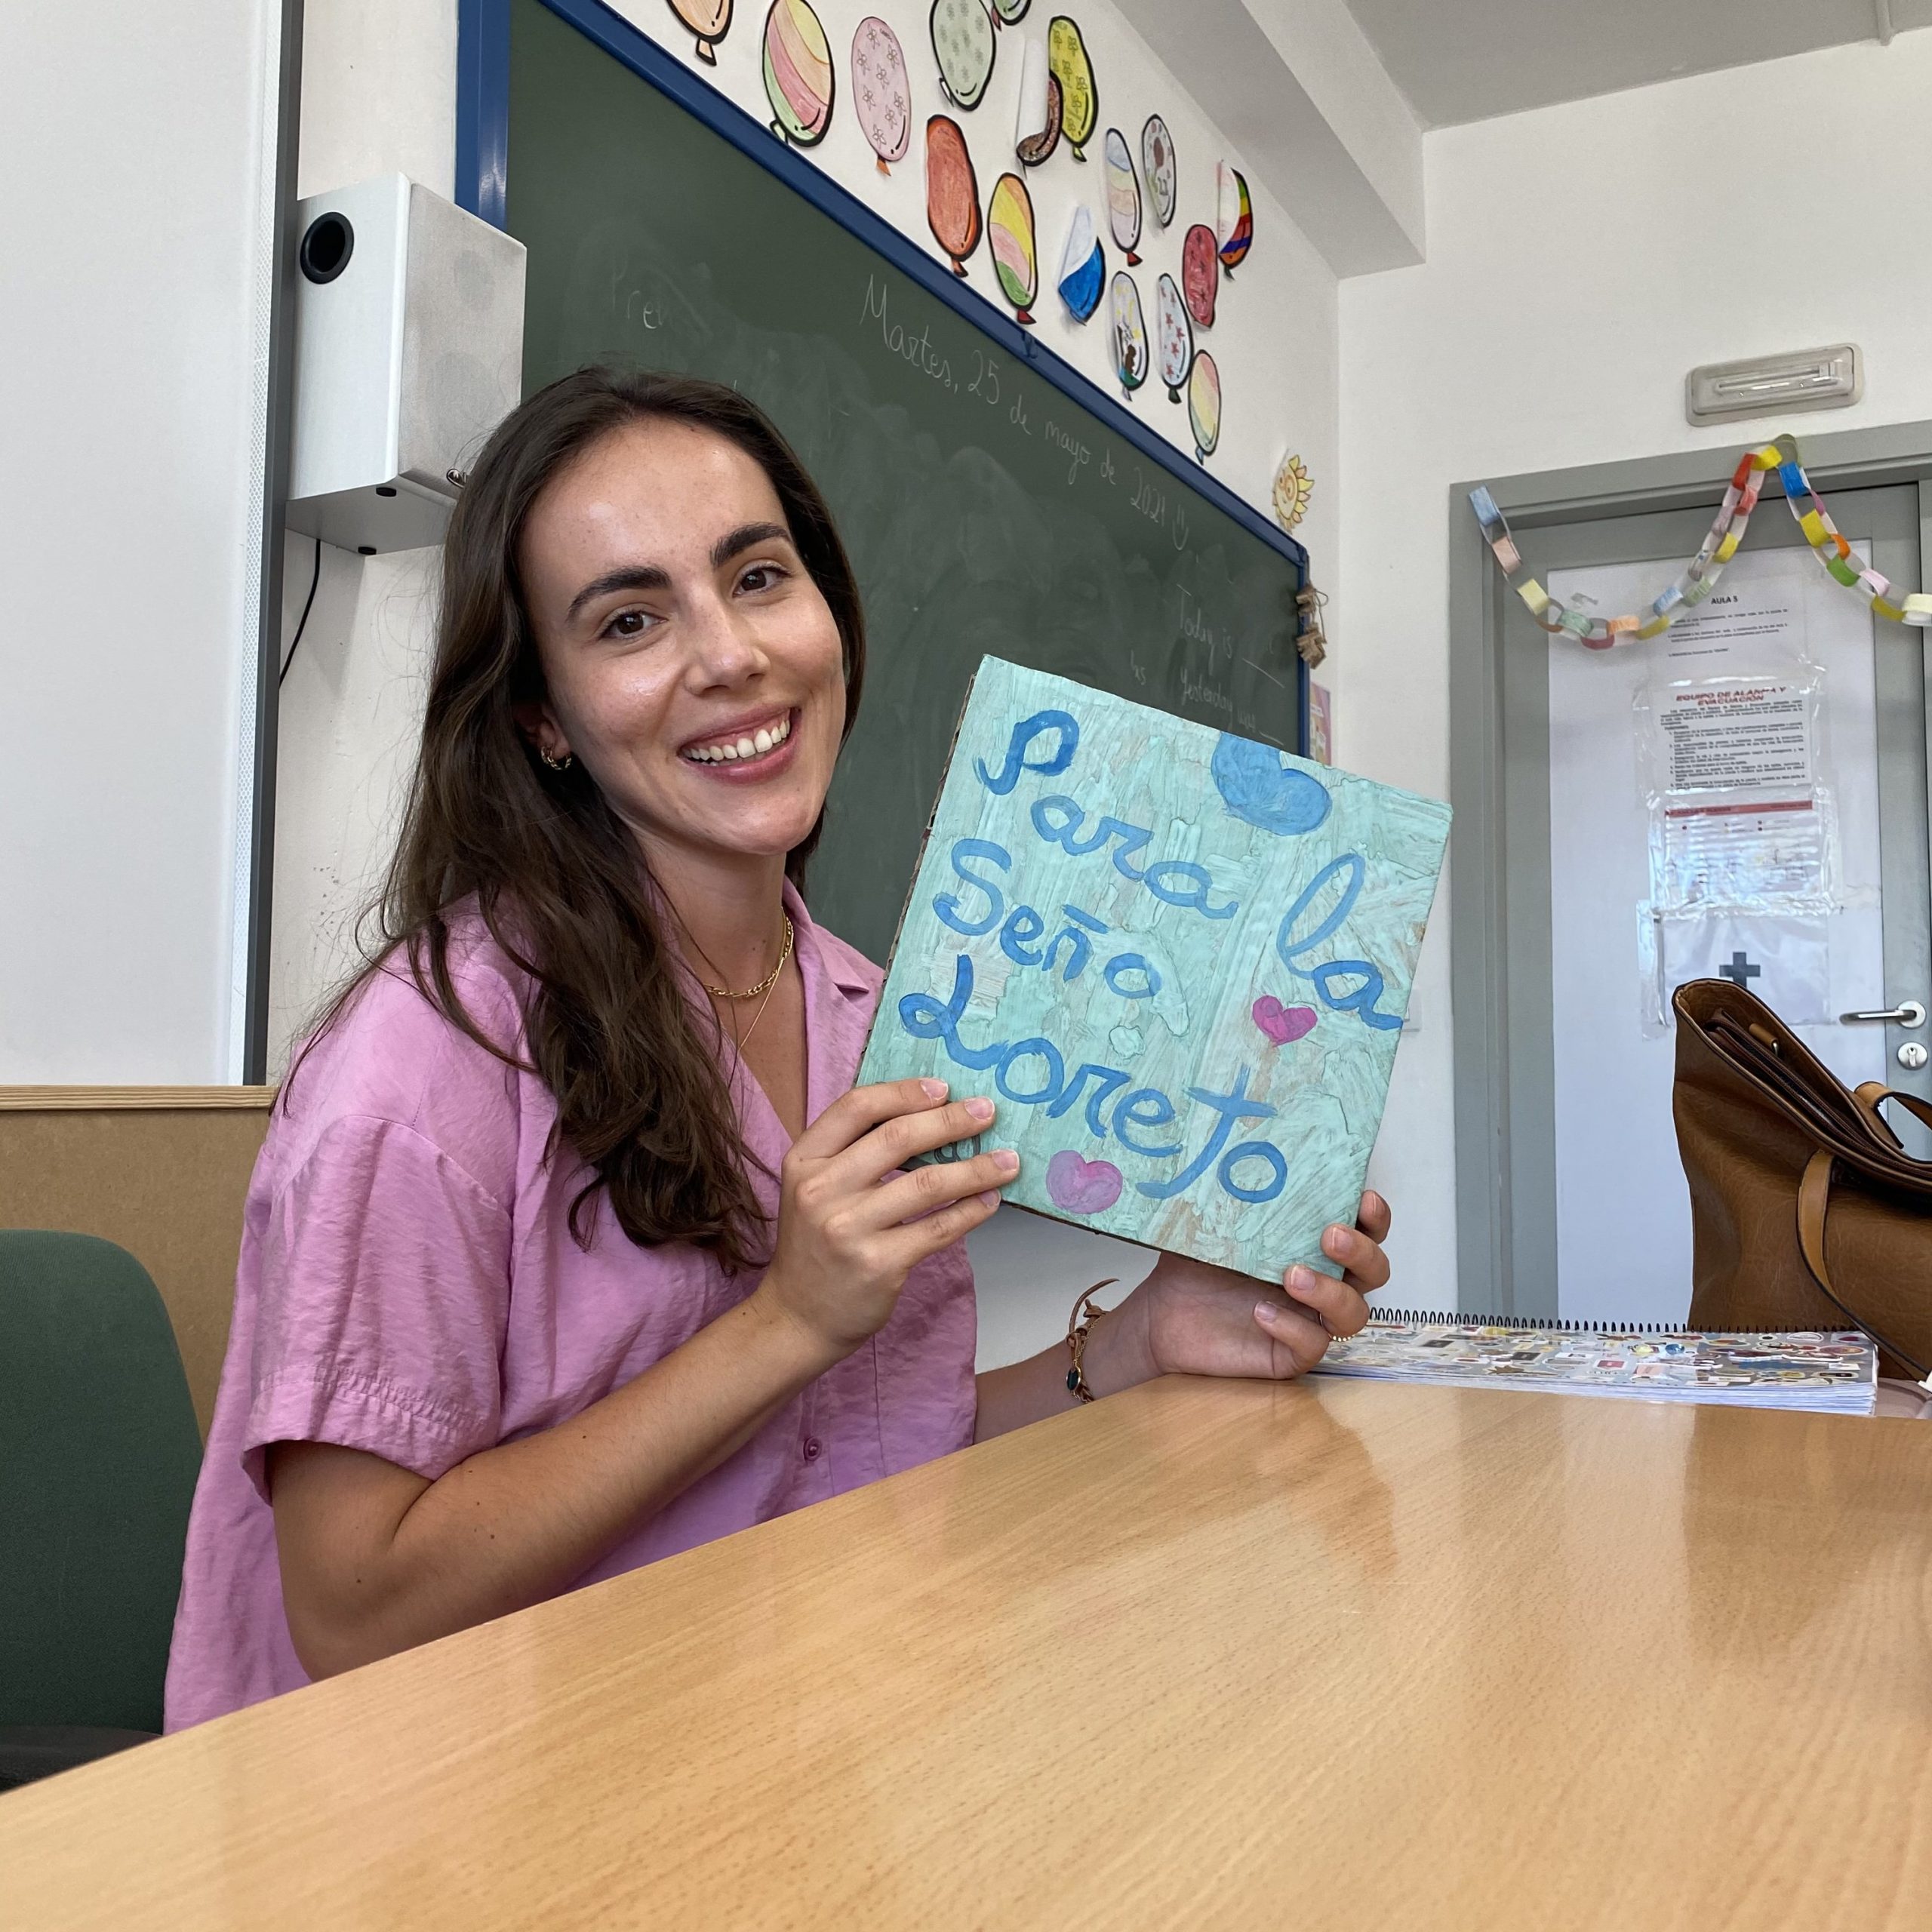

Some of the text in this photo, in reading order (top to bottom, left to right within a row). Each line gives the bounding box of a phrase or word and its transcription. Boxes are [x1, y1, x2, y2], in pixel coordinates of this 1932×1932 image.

[859, 273, 1166, 528] Martes, 25 de mayo de 2021
[1177, 583, 1216, 676] Today
[1711, 596, 1731, 605] AULA
[1676, 691, 1715, 702] EQUIPO
[932, 838, 1162, 999] Seño
[973, 709, 1403, 1031] Para la
[898, 954, 1287, 1201] Loreto
